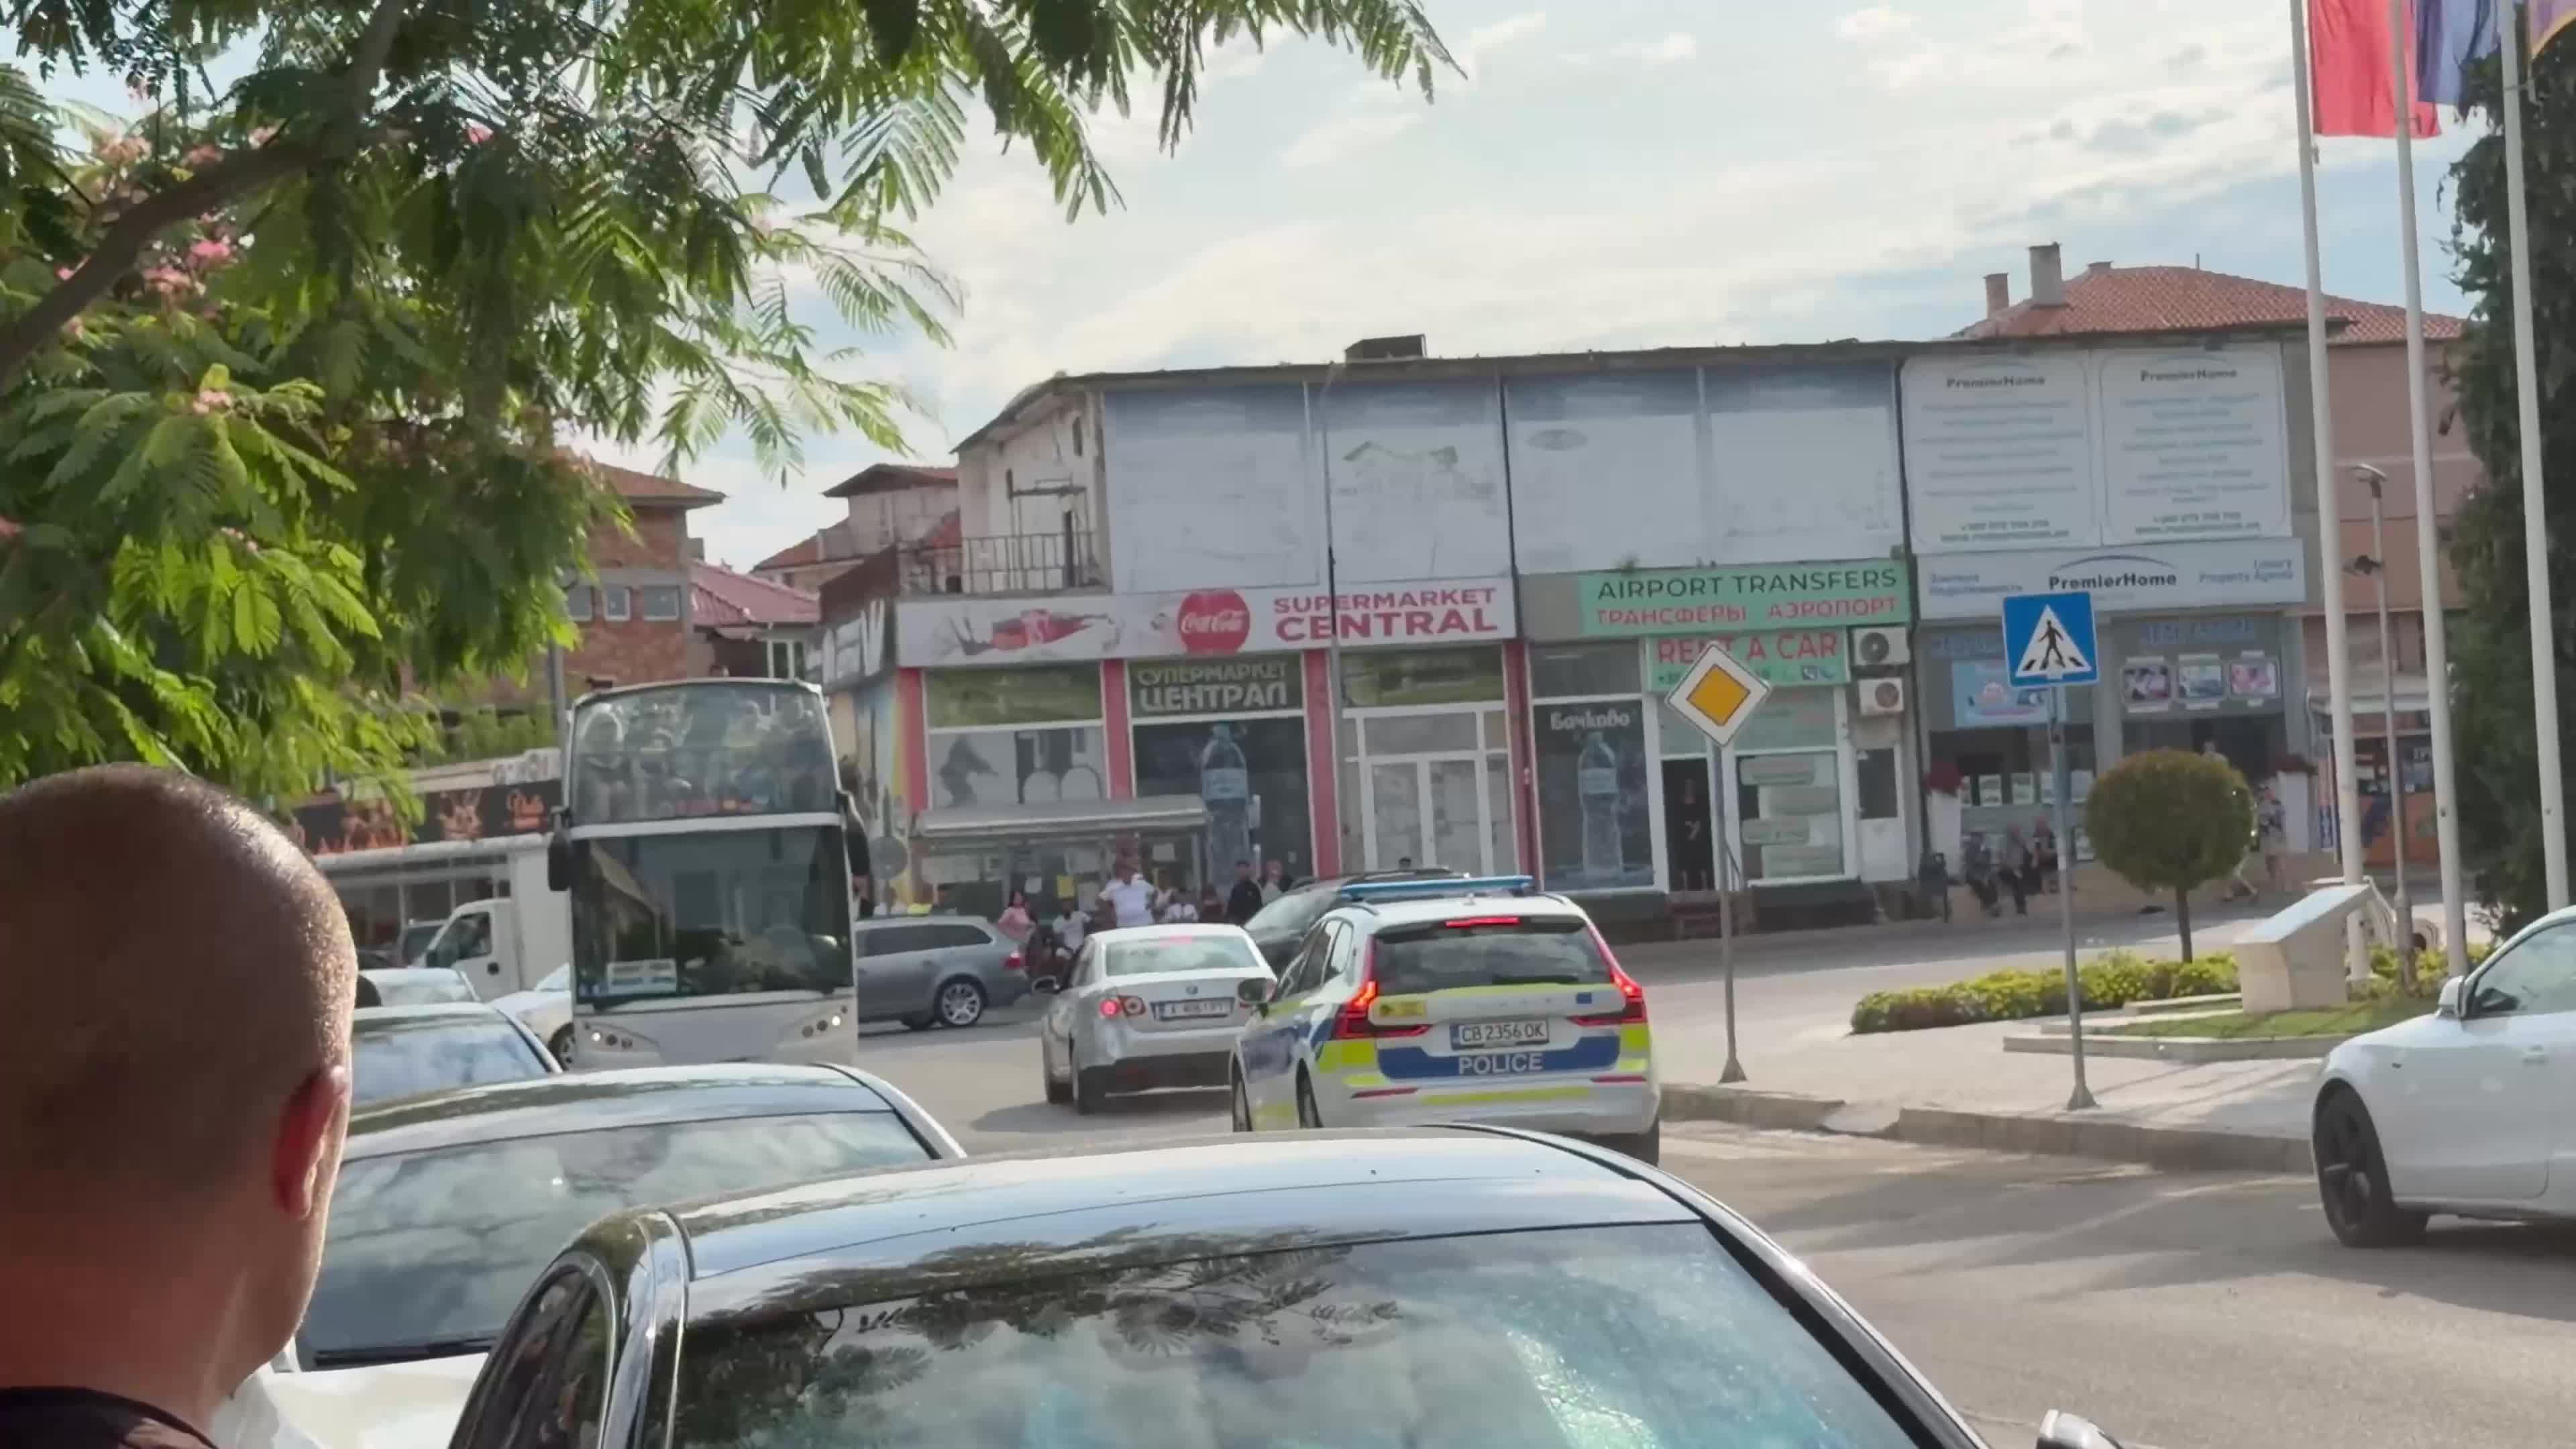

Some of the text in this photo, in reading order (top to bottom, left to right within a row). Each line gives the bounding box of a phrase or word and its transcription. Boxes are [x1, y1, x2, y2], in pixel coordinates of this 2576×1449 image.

[1598, 568, 1898, 601] AIRPORT TRANSFERS
[2049, 573, 2177, 590] PremierHome
[1275, 588, 1496, 614] SUPERMARKET
[1597, 596, 1898, 627] ТРАНСФЕРЫ АЭРОПОРТ
[1276, 608, 1499, 642] CENTRAL
[1748, 637, 1767, 661] A
[1778, 633, 1837, 660] CAR
[1138, 661, 1287, 686] СУПЕРМАРКЕТ
[1140, 681, 1287, 712] ЦЕНТРАЛ
[1459, 1053, 1544, 1075] POLICE
